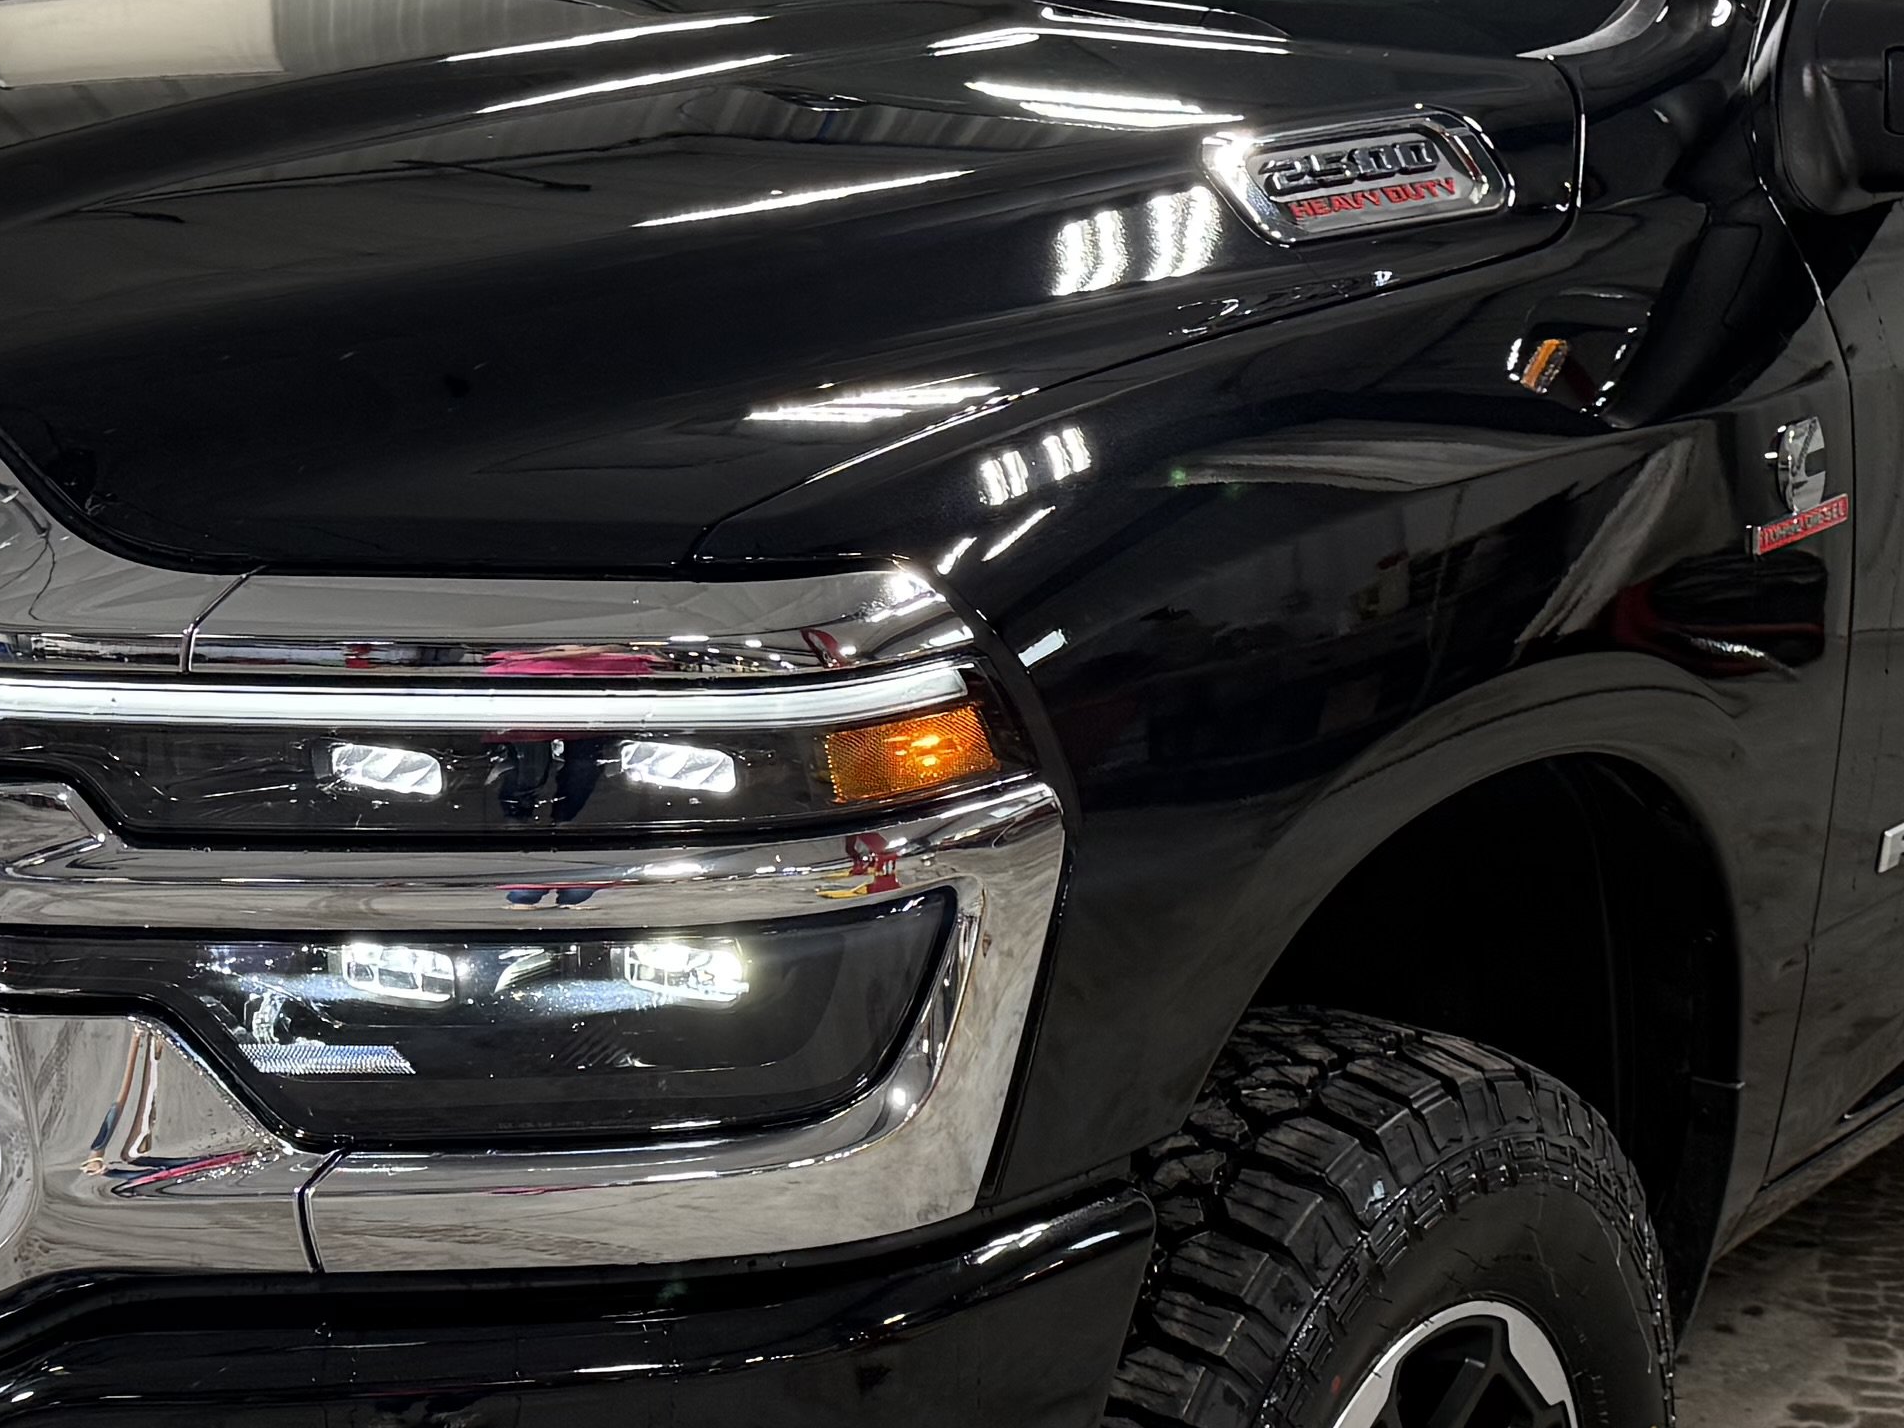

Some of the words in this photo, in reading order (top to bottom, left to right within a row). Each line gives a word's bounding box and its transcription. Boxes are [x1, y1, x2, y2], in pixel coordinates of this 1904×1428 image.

[1258, 139, 1441, 198] 2500
[1288, 187, 1383, 221] HEAVY
[1382, 177, 1457, 204] DUTY
